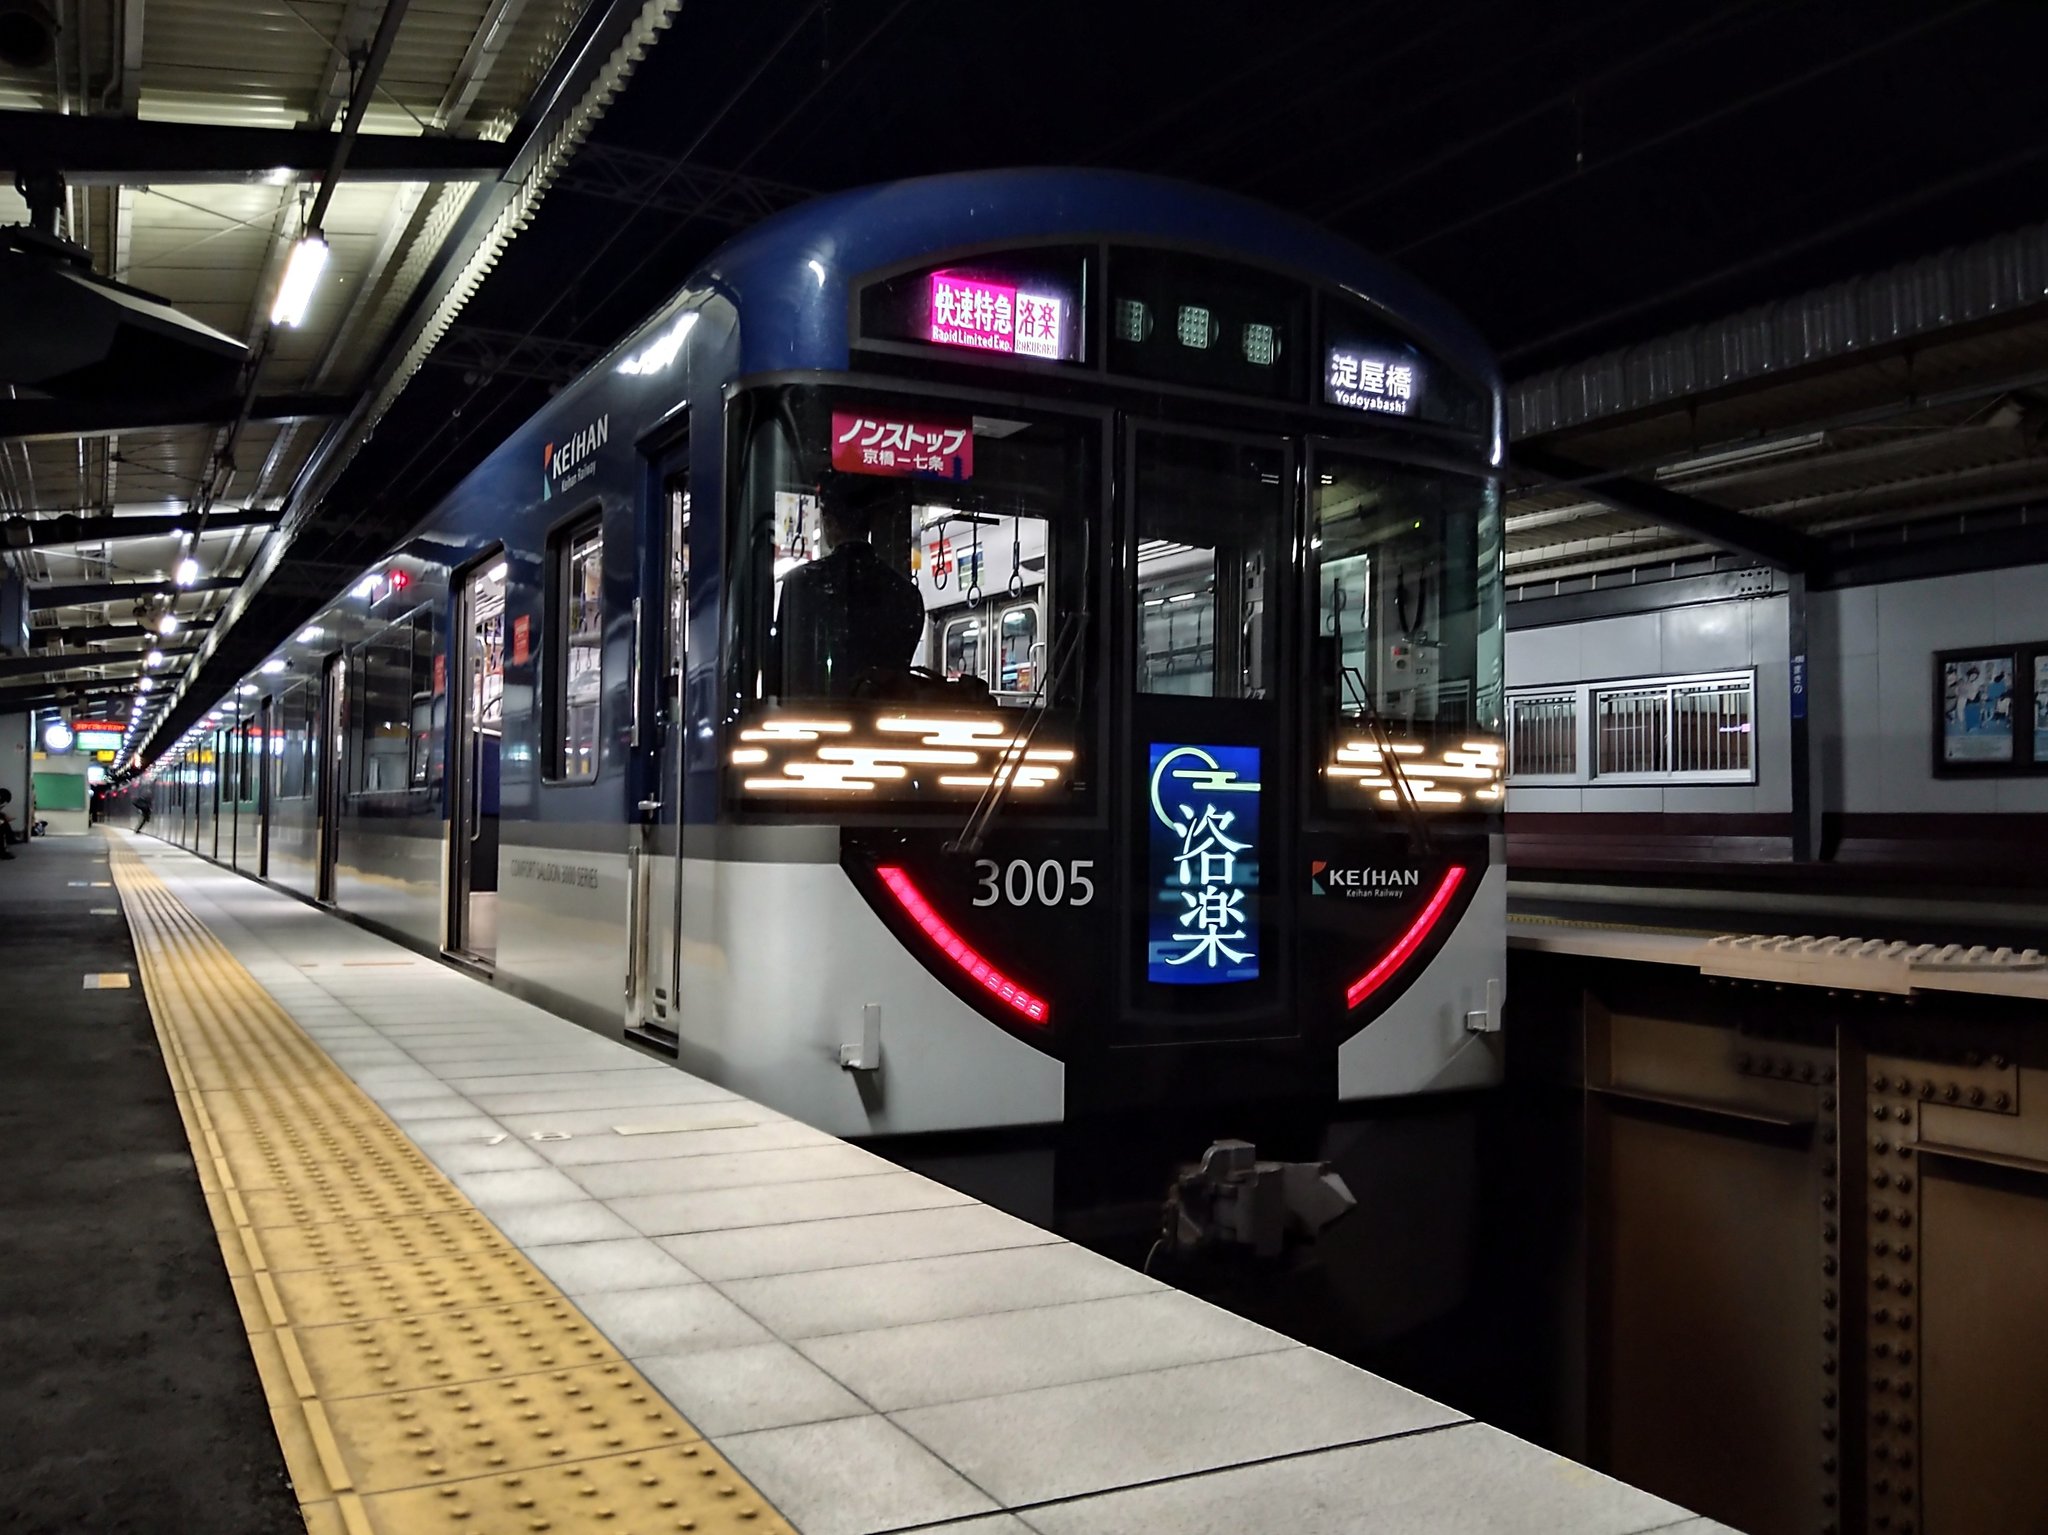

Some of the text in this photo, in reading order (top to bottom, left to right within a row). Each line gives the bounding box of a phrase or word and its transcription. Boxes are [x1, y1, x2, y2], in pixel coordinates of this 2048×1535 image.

[934, 283, 1013, 334] 快速特急
[1019, 299, 1056, 340] 洛楽
[958, 329, 993, 348] Limited
[1330, 354, 1412, 399] 淀屋橋
[1335, 389, 1406, 413] Yodoyabashi
[553, 413, 608, 480] KEIHAN
[839, 419, 967, 455] ノンストップ
[115, 700, 126, 716] 2
[972, 859, 1094, 907] 3005
[1165, 803, 1256, 967] 洛楽
[1330, 867, 1419, 886] KEIHAN
[1346, 888, 1404, 899] Keihan Railway
